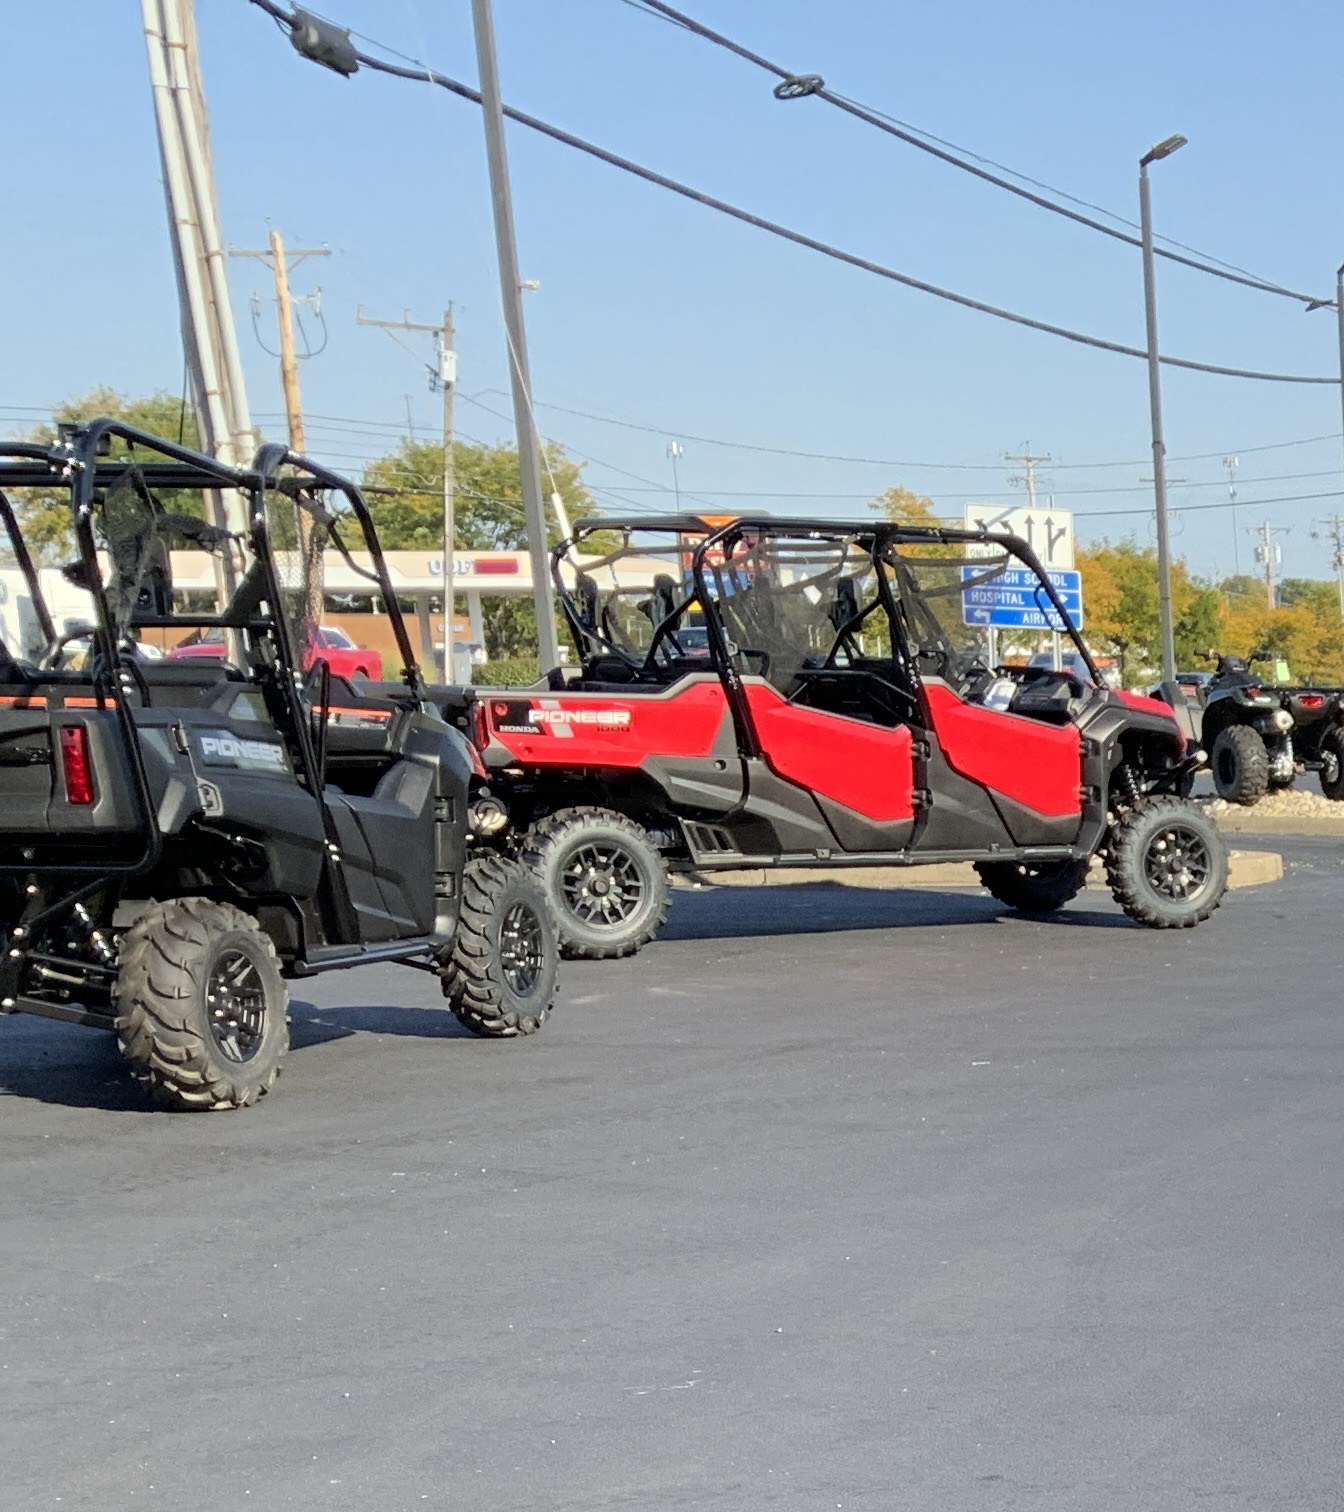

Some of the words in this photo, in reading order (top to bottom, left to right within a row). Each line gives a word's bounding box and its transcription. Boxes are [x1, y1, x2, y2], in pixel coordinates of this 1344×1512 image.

[969, 548, 991, 557] ONLY
[1024, 573, 1068, 586] SCOOL
[971, 591, 1025, 605] HOSPITAL
[1022, 612, 1065, 625] AIRPOR
[529, 709, 631, 724] PIONEER
[499, 725, 540, 733] HONDA
[200, 737, 284, 763] PIONEER
